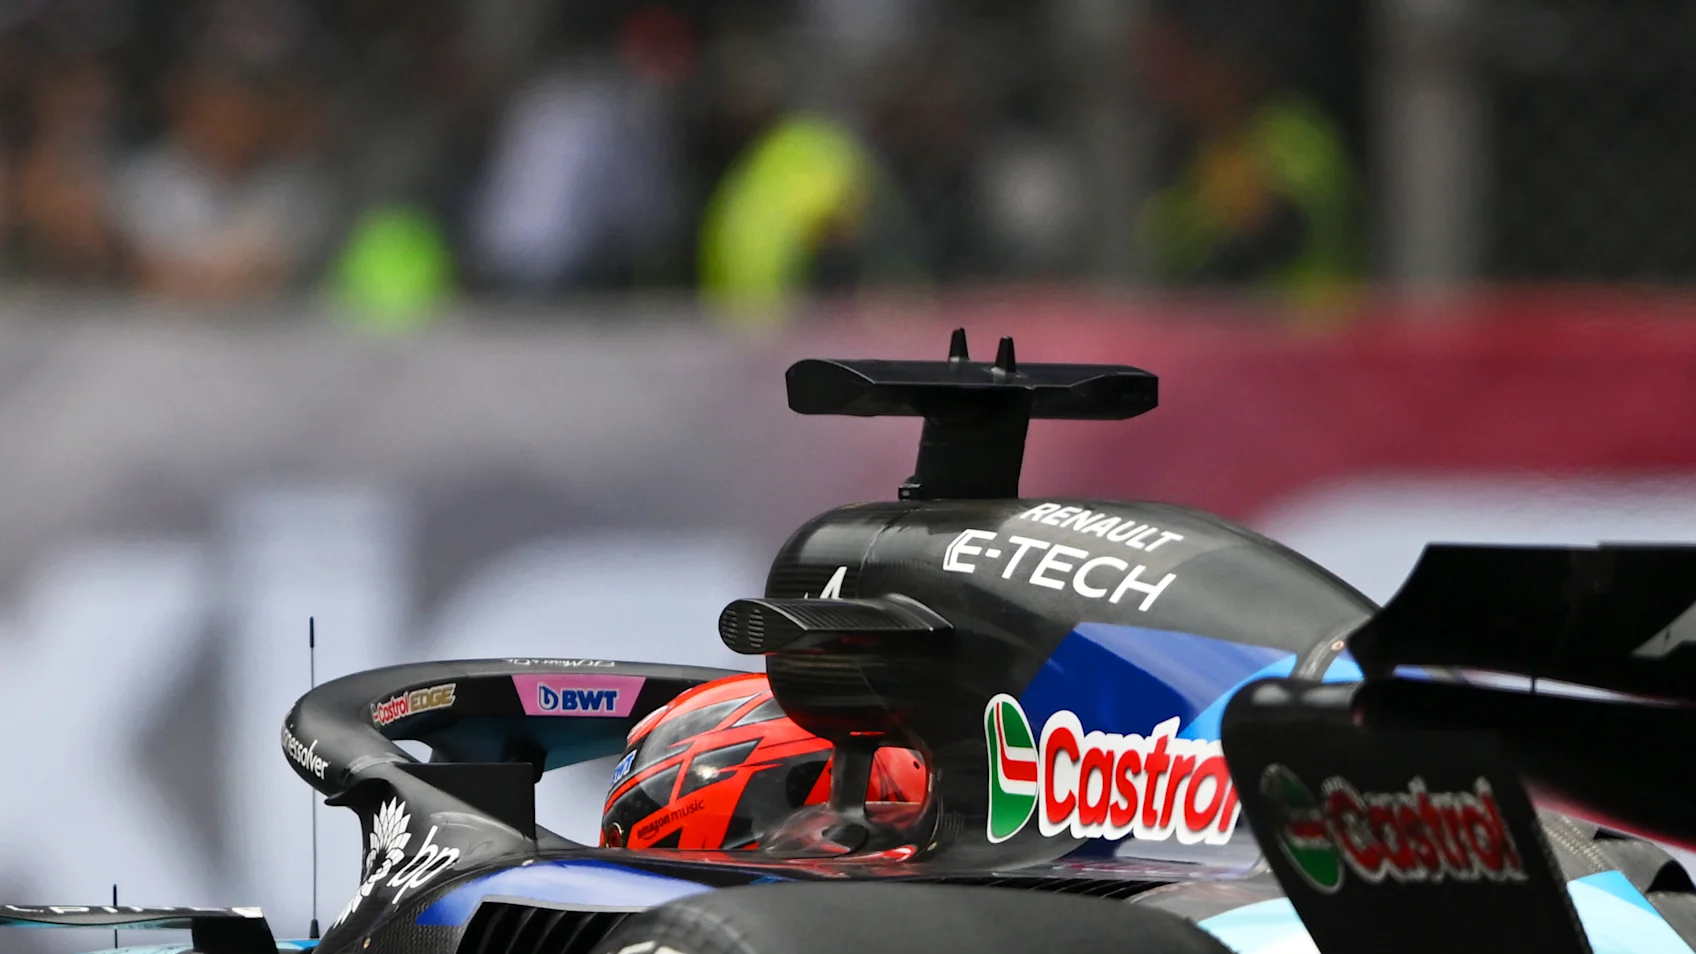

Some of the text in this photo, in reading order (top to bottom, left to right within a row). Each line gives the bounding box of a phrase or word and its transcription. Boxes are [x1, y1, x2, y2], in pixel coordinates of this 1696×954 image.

[1020, 503, 1184, 552] RENAULT
[943, 529, 1177, 612] E-TECH
[378, 683, 456, 725] Castrol EDGE
[561, 689, 618, 711] BWT
[637, 800, 706, 840] amazon music
[1324, 778, 1528, 881] Castrol
[386, 825, 460, 904] bp
